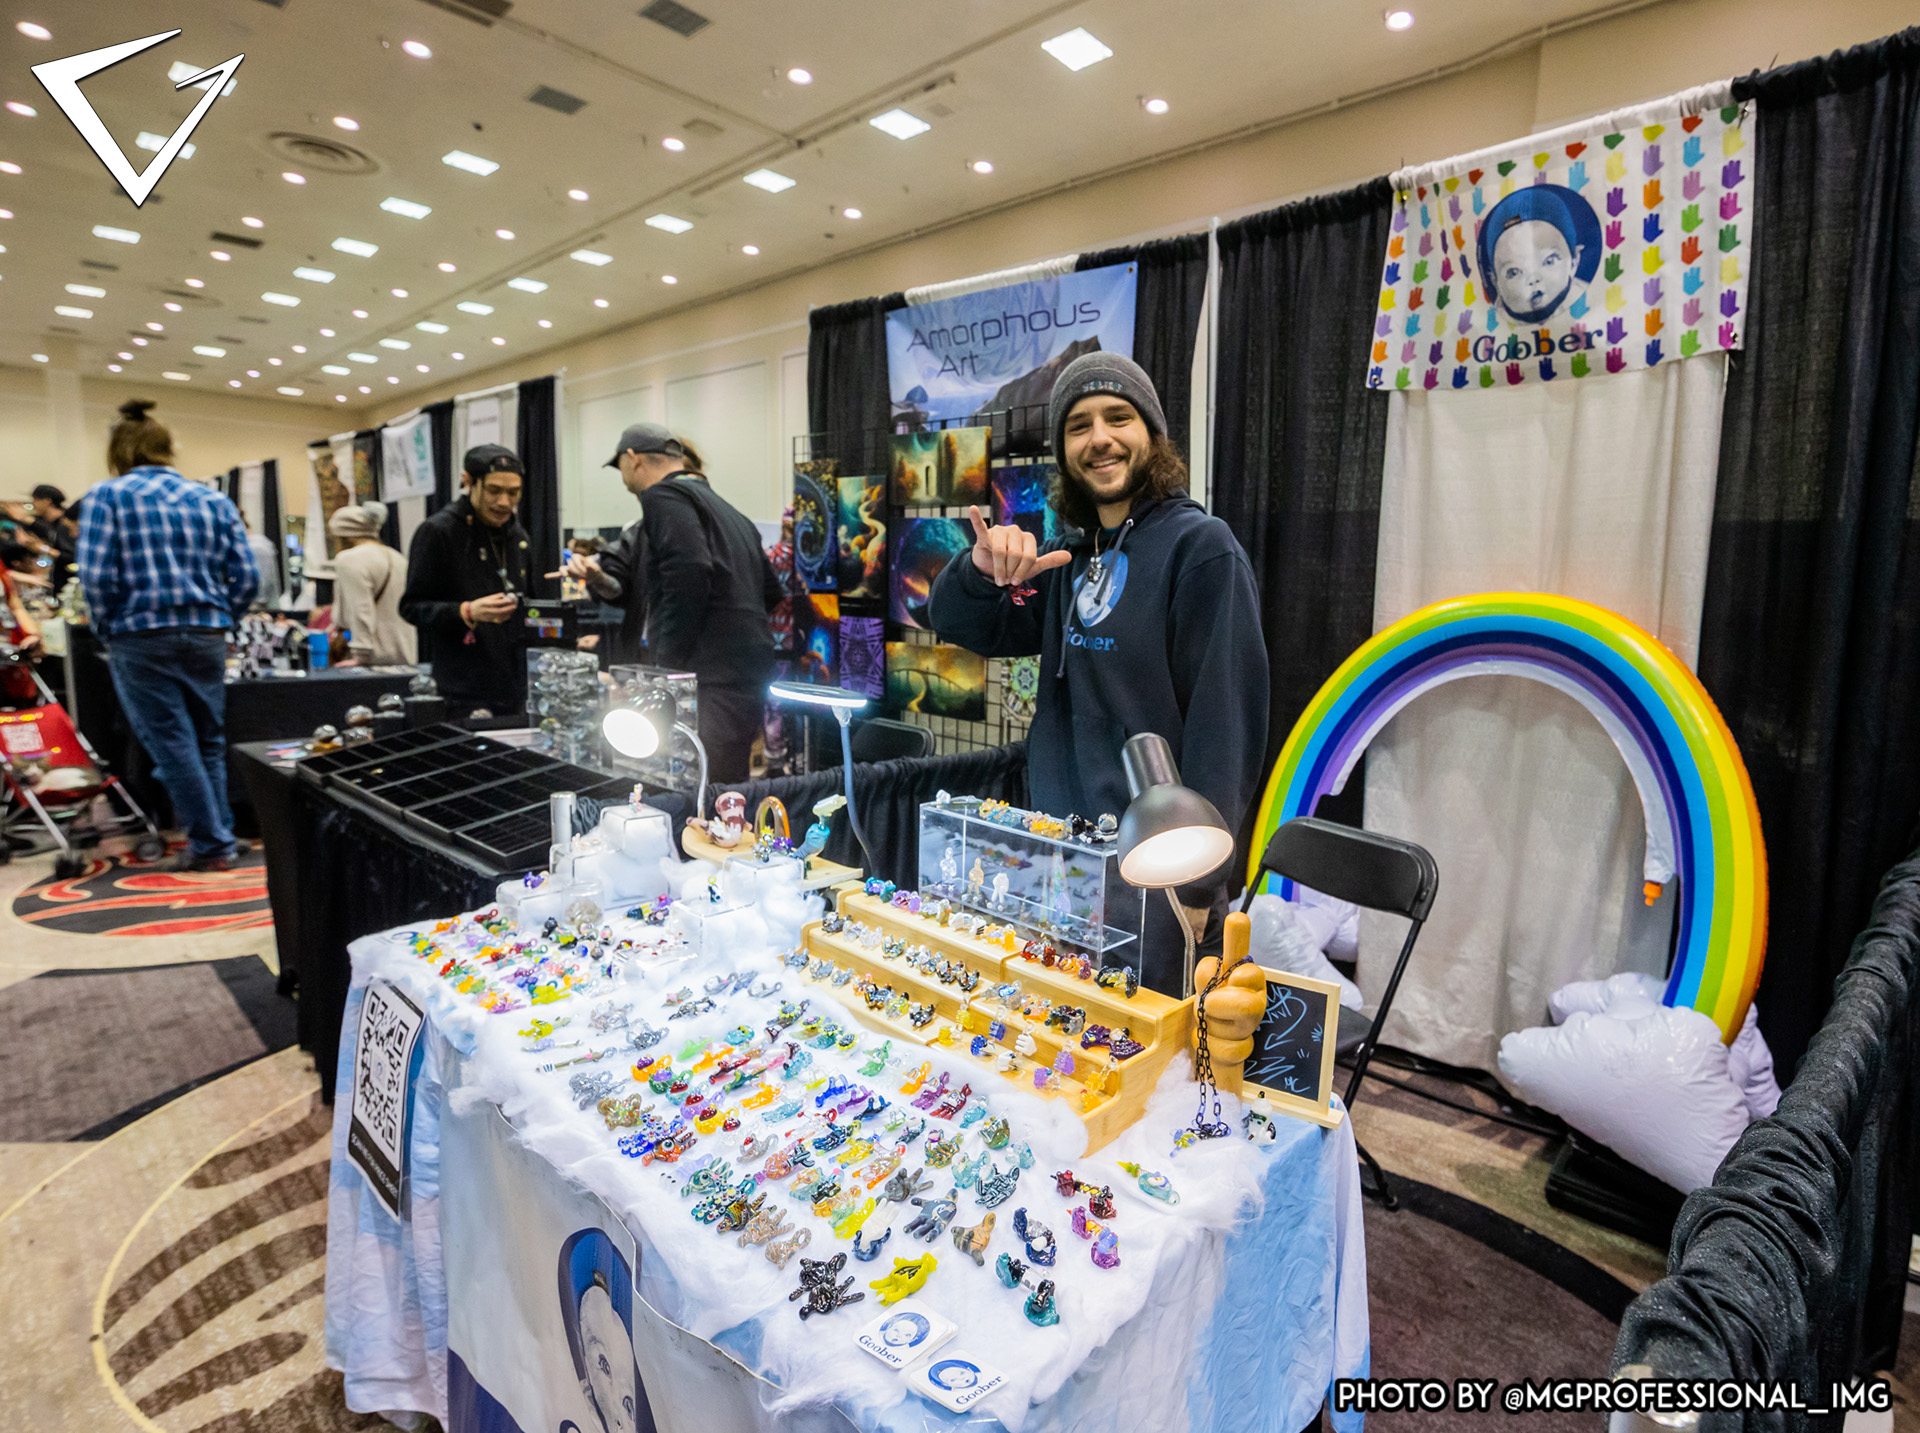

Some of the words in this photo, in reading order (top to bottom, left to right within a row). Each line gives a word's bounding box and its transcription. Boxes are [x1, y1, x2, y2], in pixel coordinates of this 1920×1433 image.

[906, 301, 1101, 352] Amorphous
[1472, 328, 1604, 363] Goober
[936, 350, 979, 379] Art
[858, 1334, 902, 1364] Goober
[955, 1375, 1002, 1405] Goober
